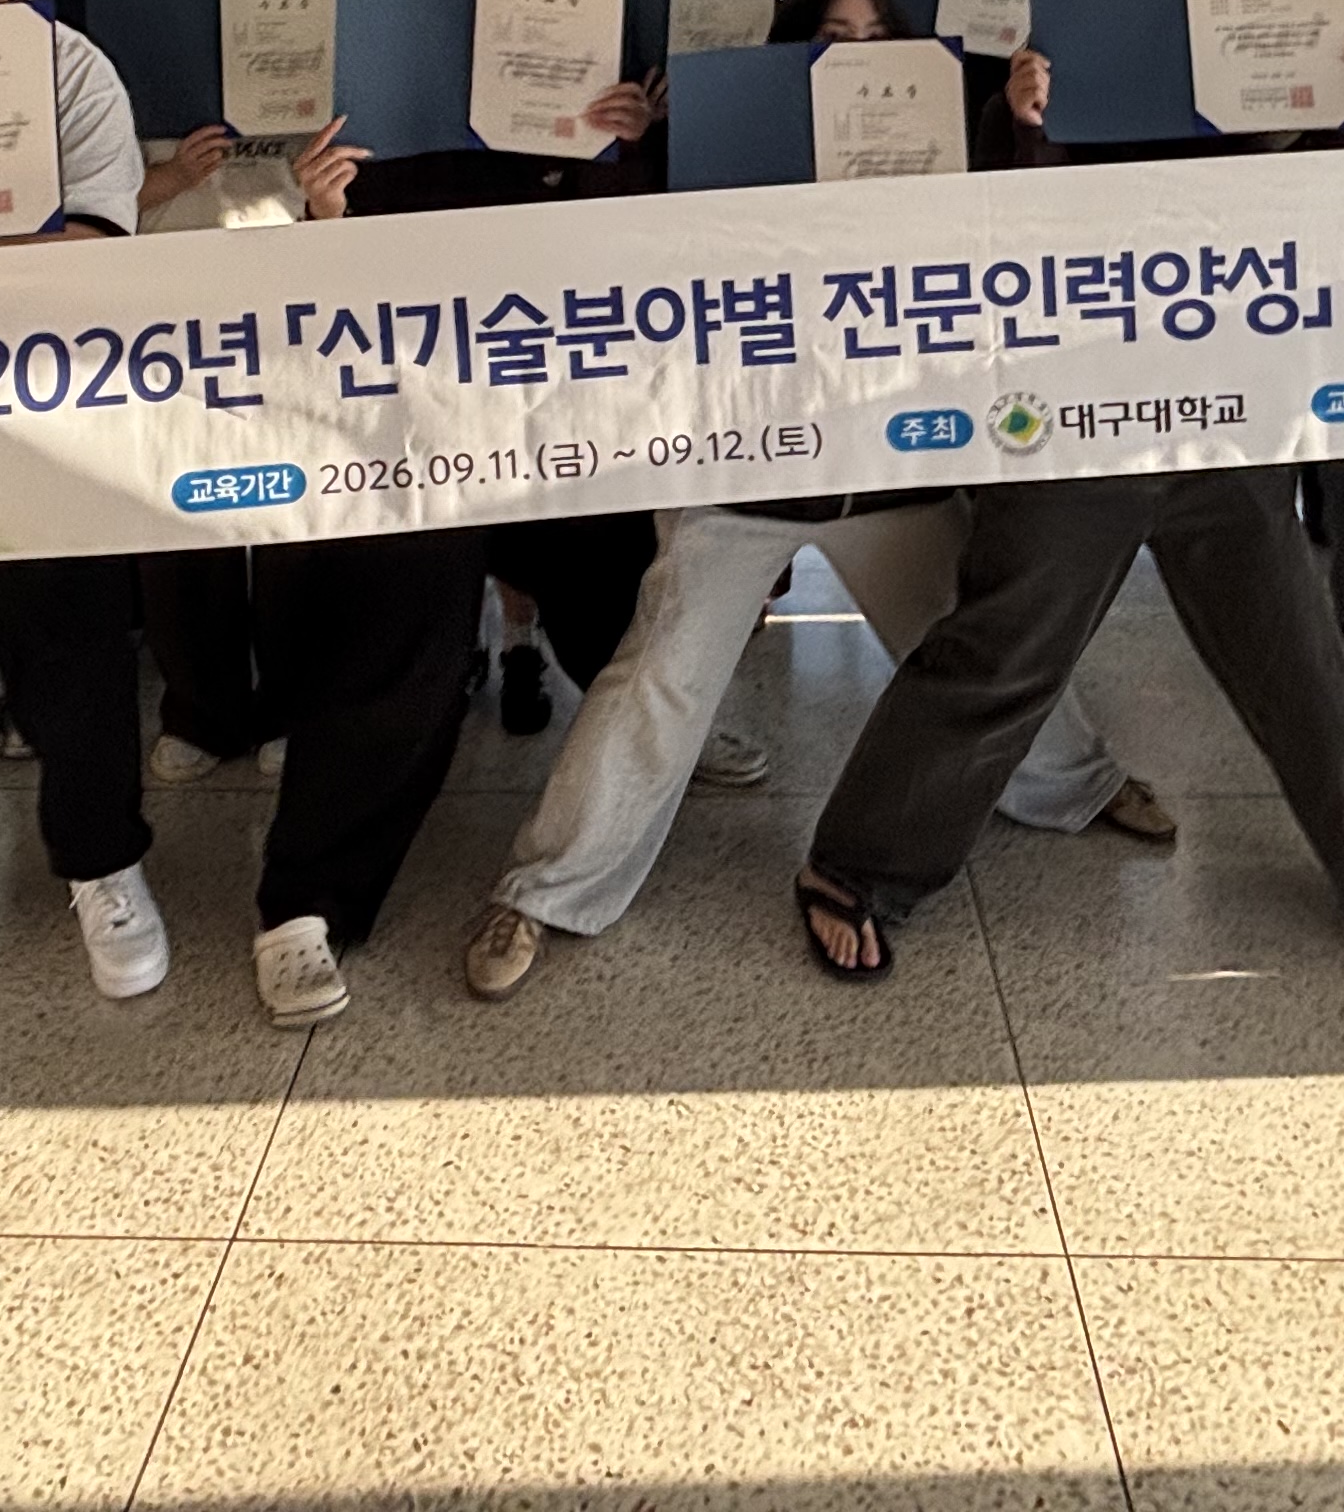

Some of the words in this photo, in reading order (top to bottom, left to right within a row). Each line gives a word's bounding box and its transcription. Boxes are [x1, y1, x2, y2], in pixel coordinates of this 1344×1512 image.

[899, 415, 957, 445] 주최
[1060, 394, 1247, 440] 대구대학교
[187, 469, 294, 505] 교육기간
[319, 439, 600, 497] 2026.09.11.(금)
[648, 423, 823, 468] 09.12.(토)
